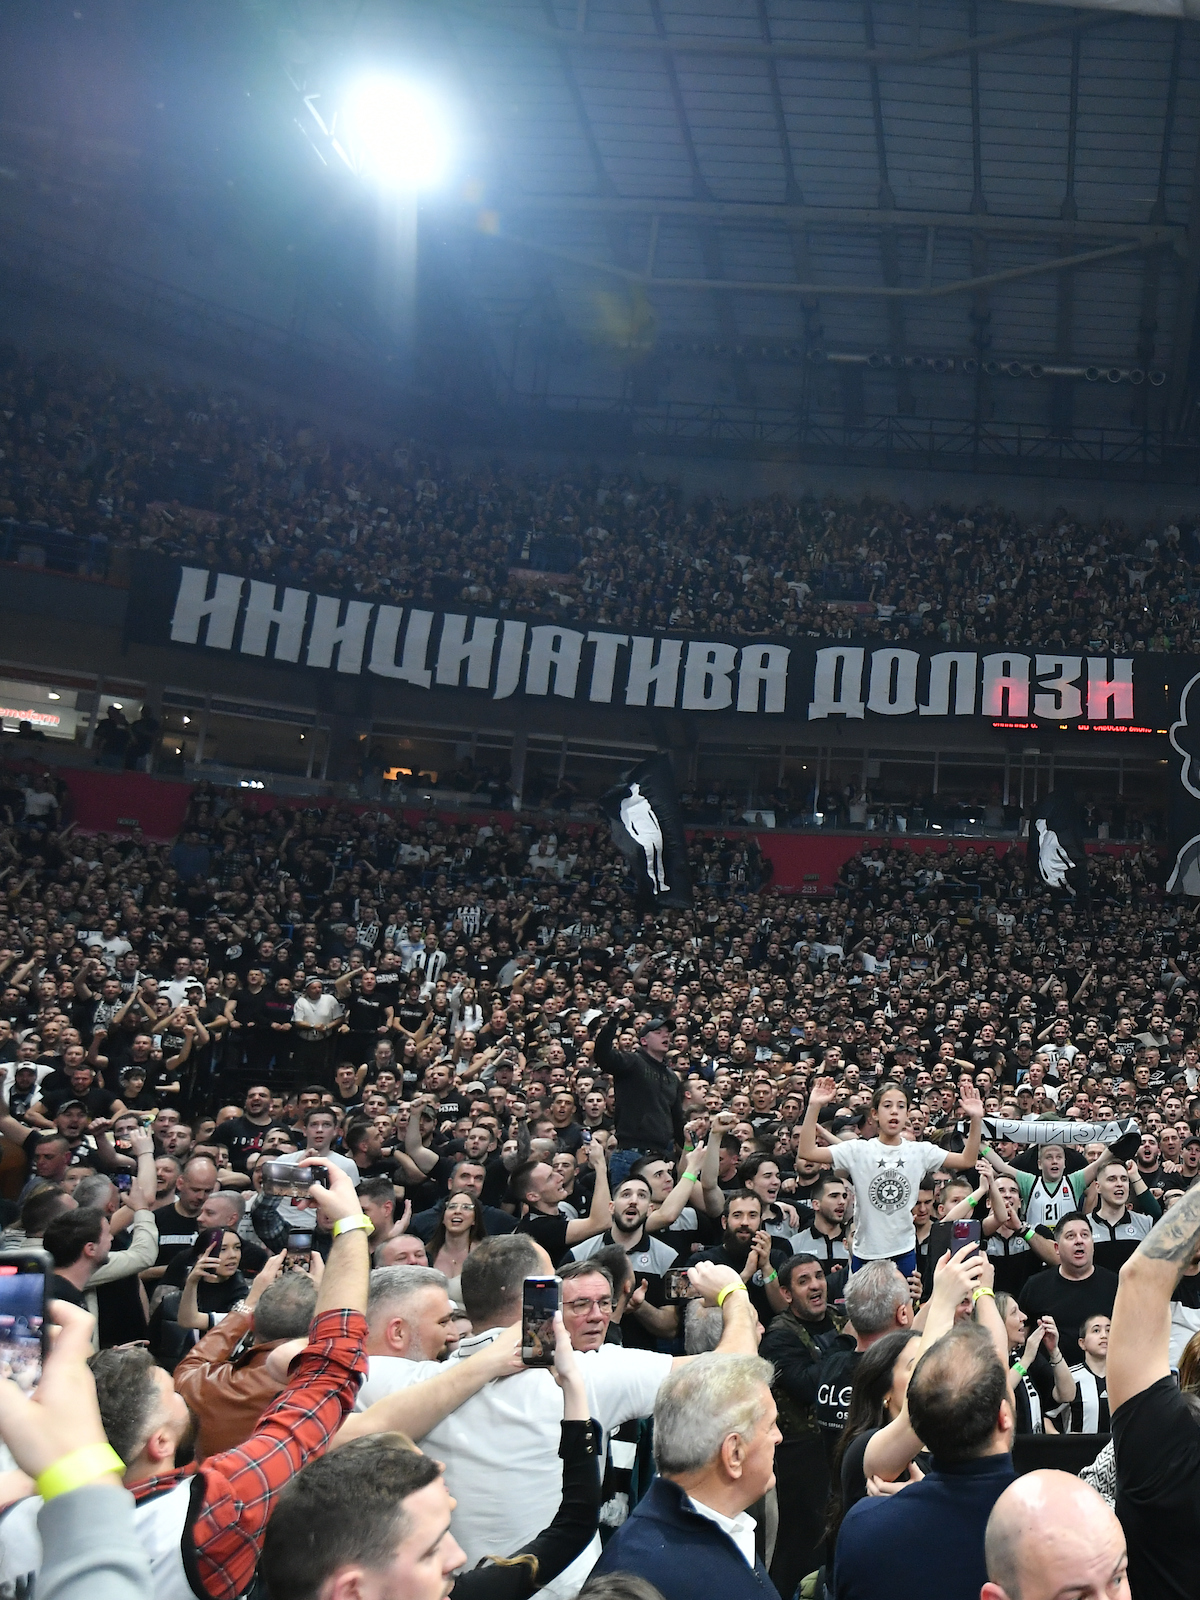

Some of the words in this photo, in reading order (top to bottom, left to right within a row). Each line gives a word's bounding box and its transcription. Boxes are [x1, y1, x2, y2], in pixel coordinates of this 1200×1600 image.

[171, 567, 790, 712] ИНИЦИЈАТИВА
[809, 647, 1133, 720] ДОЛАЗИ
[0, 707, 60, 724] emofarm
[802, 885, 818, 894] 223
[1045, 1204, 1059, 1220] 21
